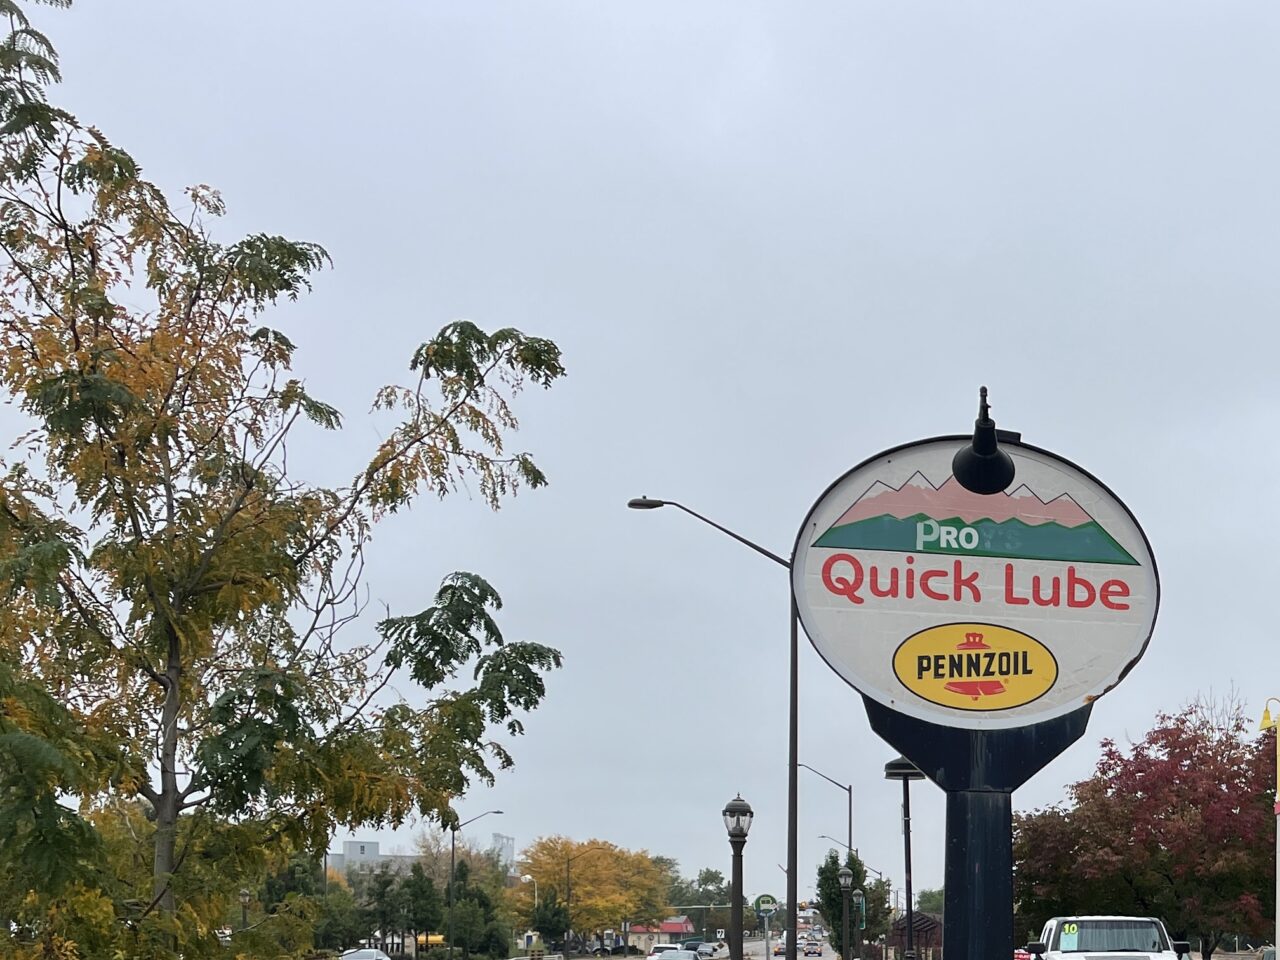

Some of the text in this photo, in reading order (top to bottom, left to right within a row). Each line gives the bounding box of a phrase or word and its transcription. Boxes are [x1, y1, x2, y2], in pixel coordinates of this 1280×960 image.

[821, 553, 1130, 610] Quick Lube
[917, 651, 1033, 680] PENNZOIL
